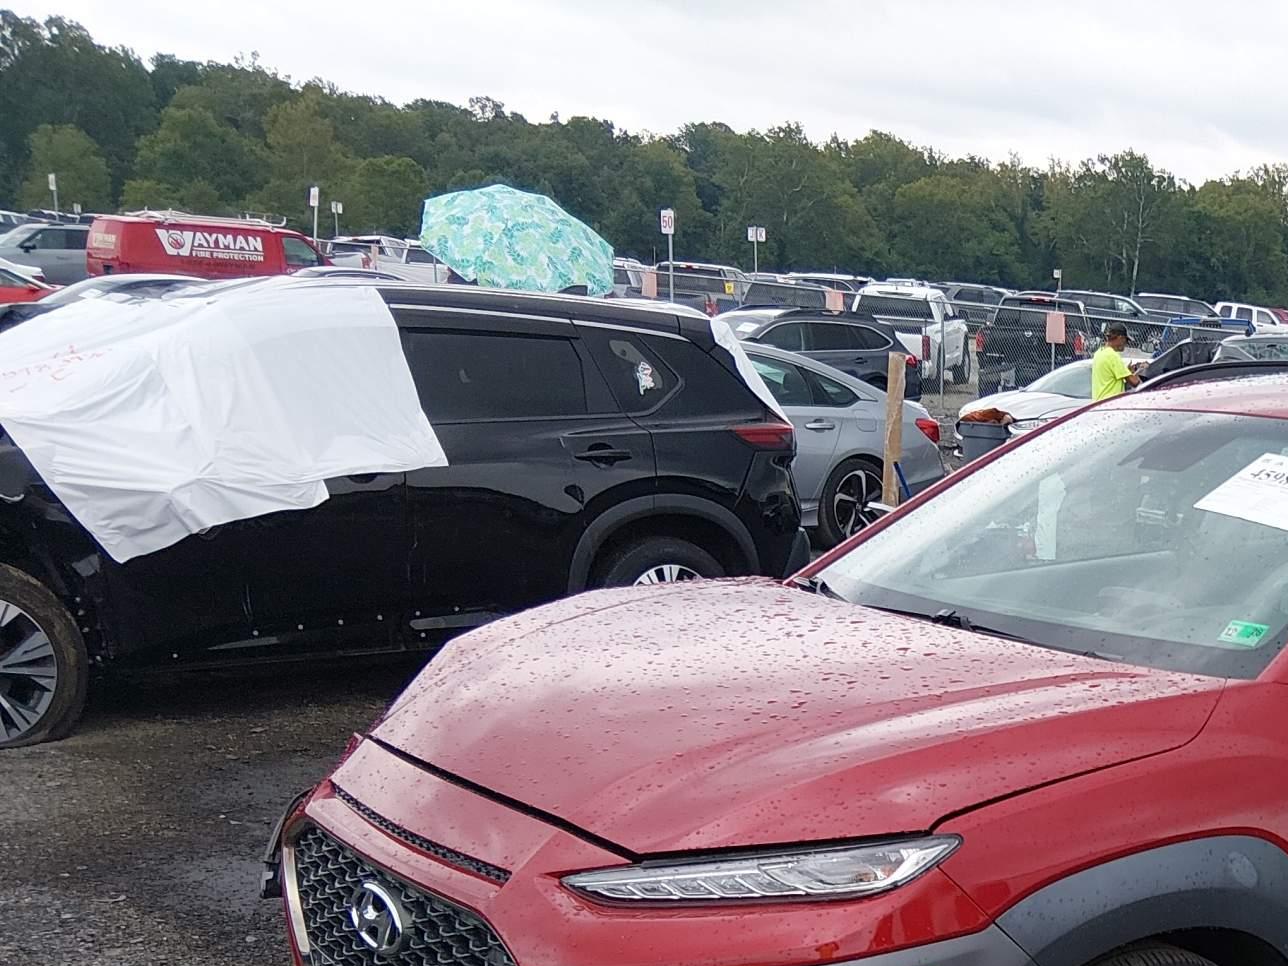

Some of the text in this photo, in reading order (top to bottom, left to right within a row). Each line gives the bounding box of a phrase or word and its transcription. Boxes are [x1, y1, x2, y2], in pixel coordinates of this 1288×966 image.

[662, 215, 673, 229] 50
[155, 228, 264, 256] WAYMAN
[192, 250, 264, 262] FIRE PROTECTION
